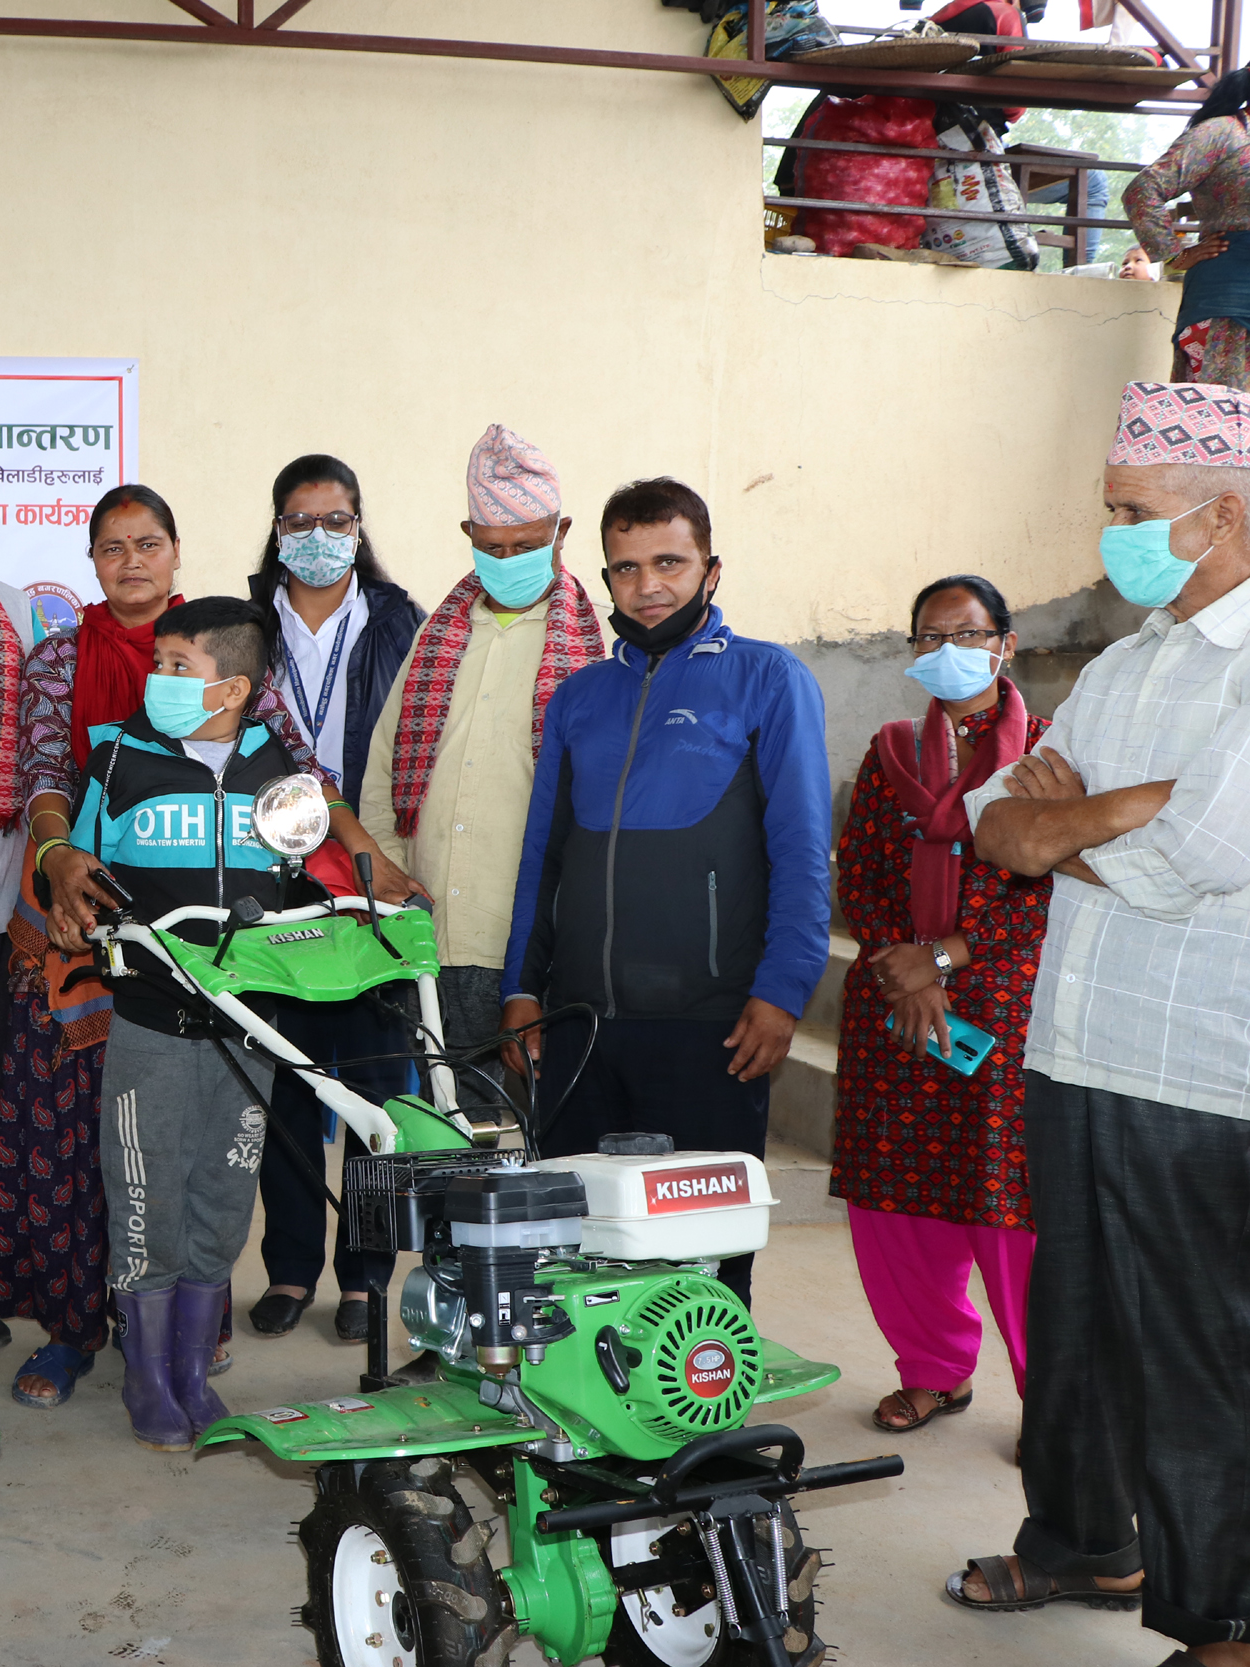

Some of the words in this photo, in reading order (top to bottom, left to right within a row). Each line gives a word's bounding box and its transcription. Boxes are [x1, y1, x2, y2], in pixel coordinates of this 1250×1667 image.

[16, 498, 97, 527] कार्यक्र
[664, 716, 686, 726] ANTA
[268, 928, 325, 944] KISHAN
[656, 1174, 737, 1200] KISHAN
[127, 1185, 148, 1258] SPORT
[691, 1368, 730, 1384] KISHAN
